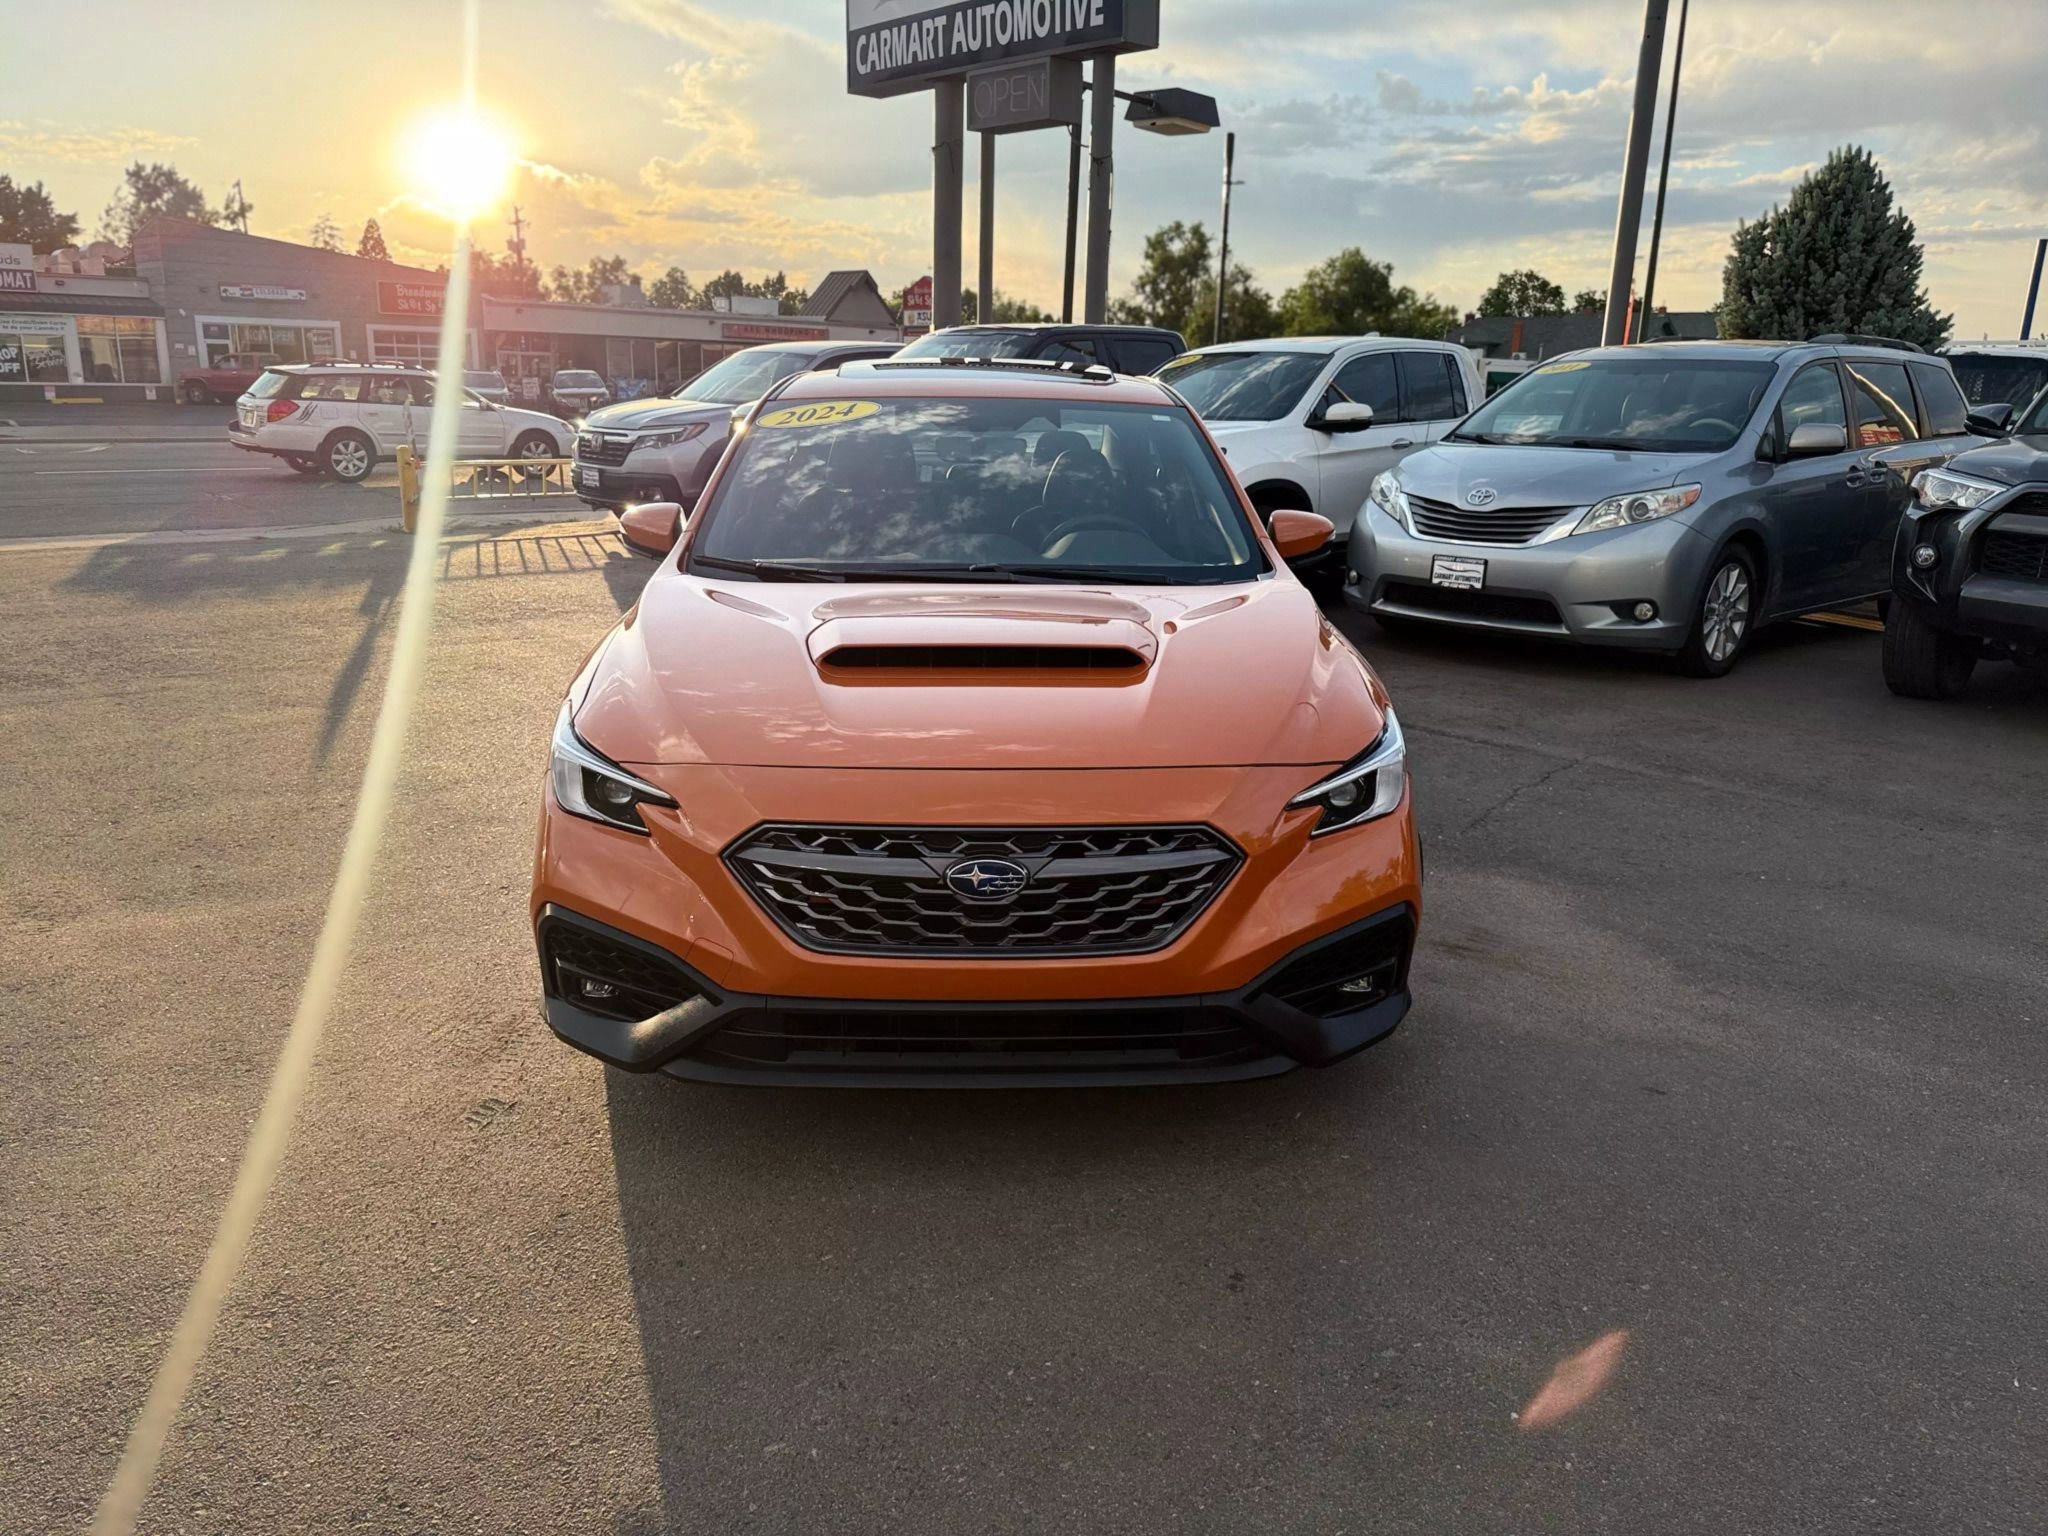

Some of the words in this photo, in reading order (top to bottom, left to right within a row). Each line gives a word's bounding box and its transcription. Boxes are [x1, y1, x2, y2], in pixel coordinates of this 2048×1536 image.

[856, 15, 947, 75] CARMART
[952, 0, 1104, 55] AUTOMOTIVE
[973, 72, 1046, 121] OPEN
[775, 402, 857, 426] 2024
